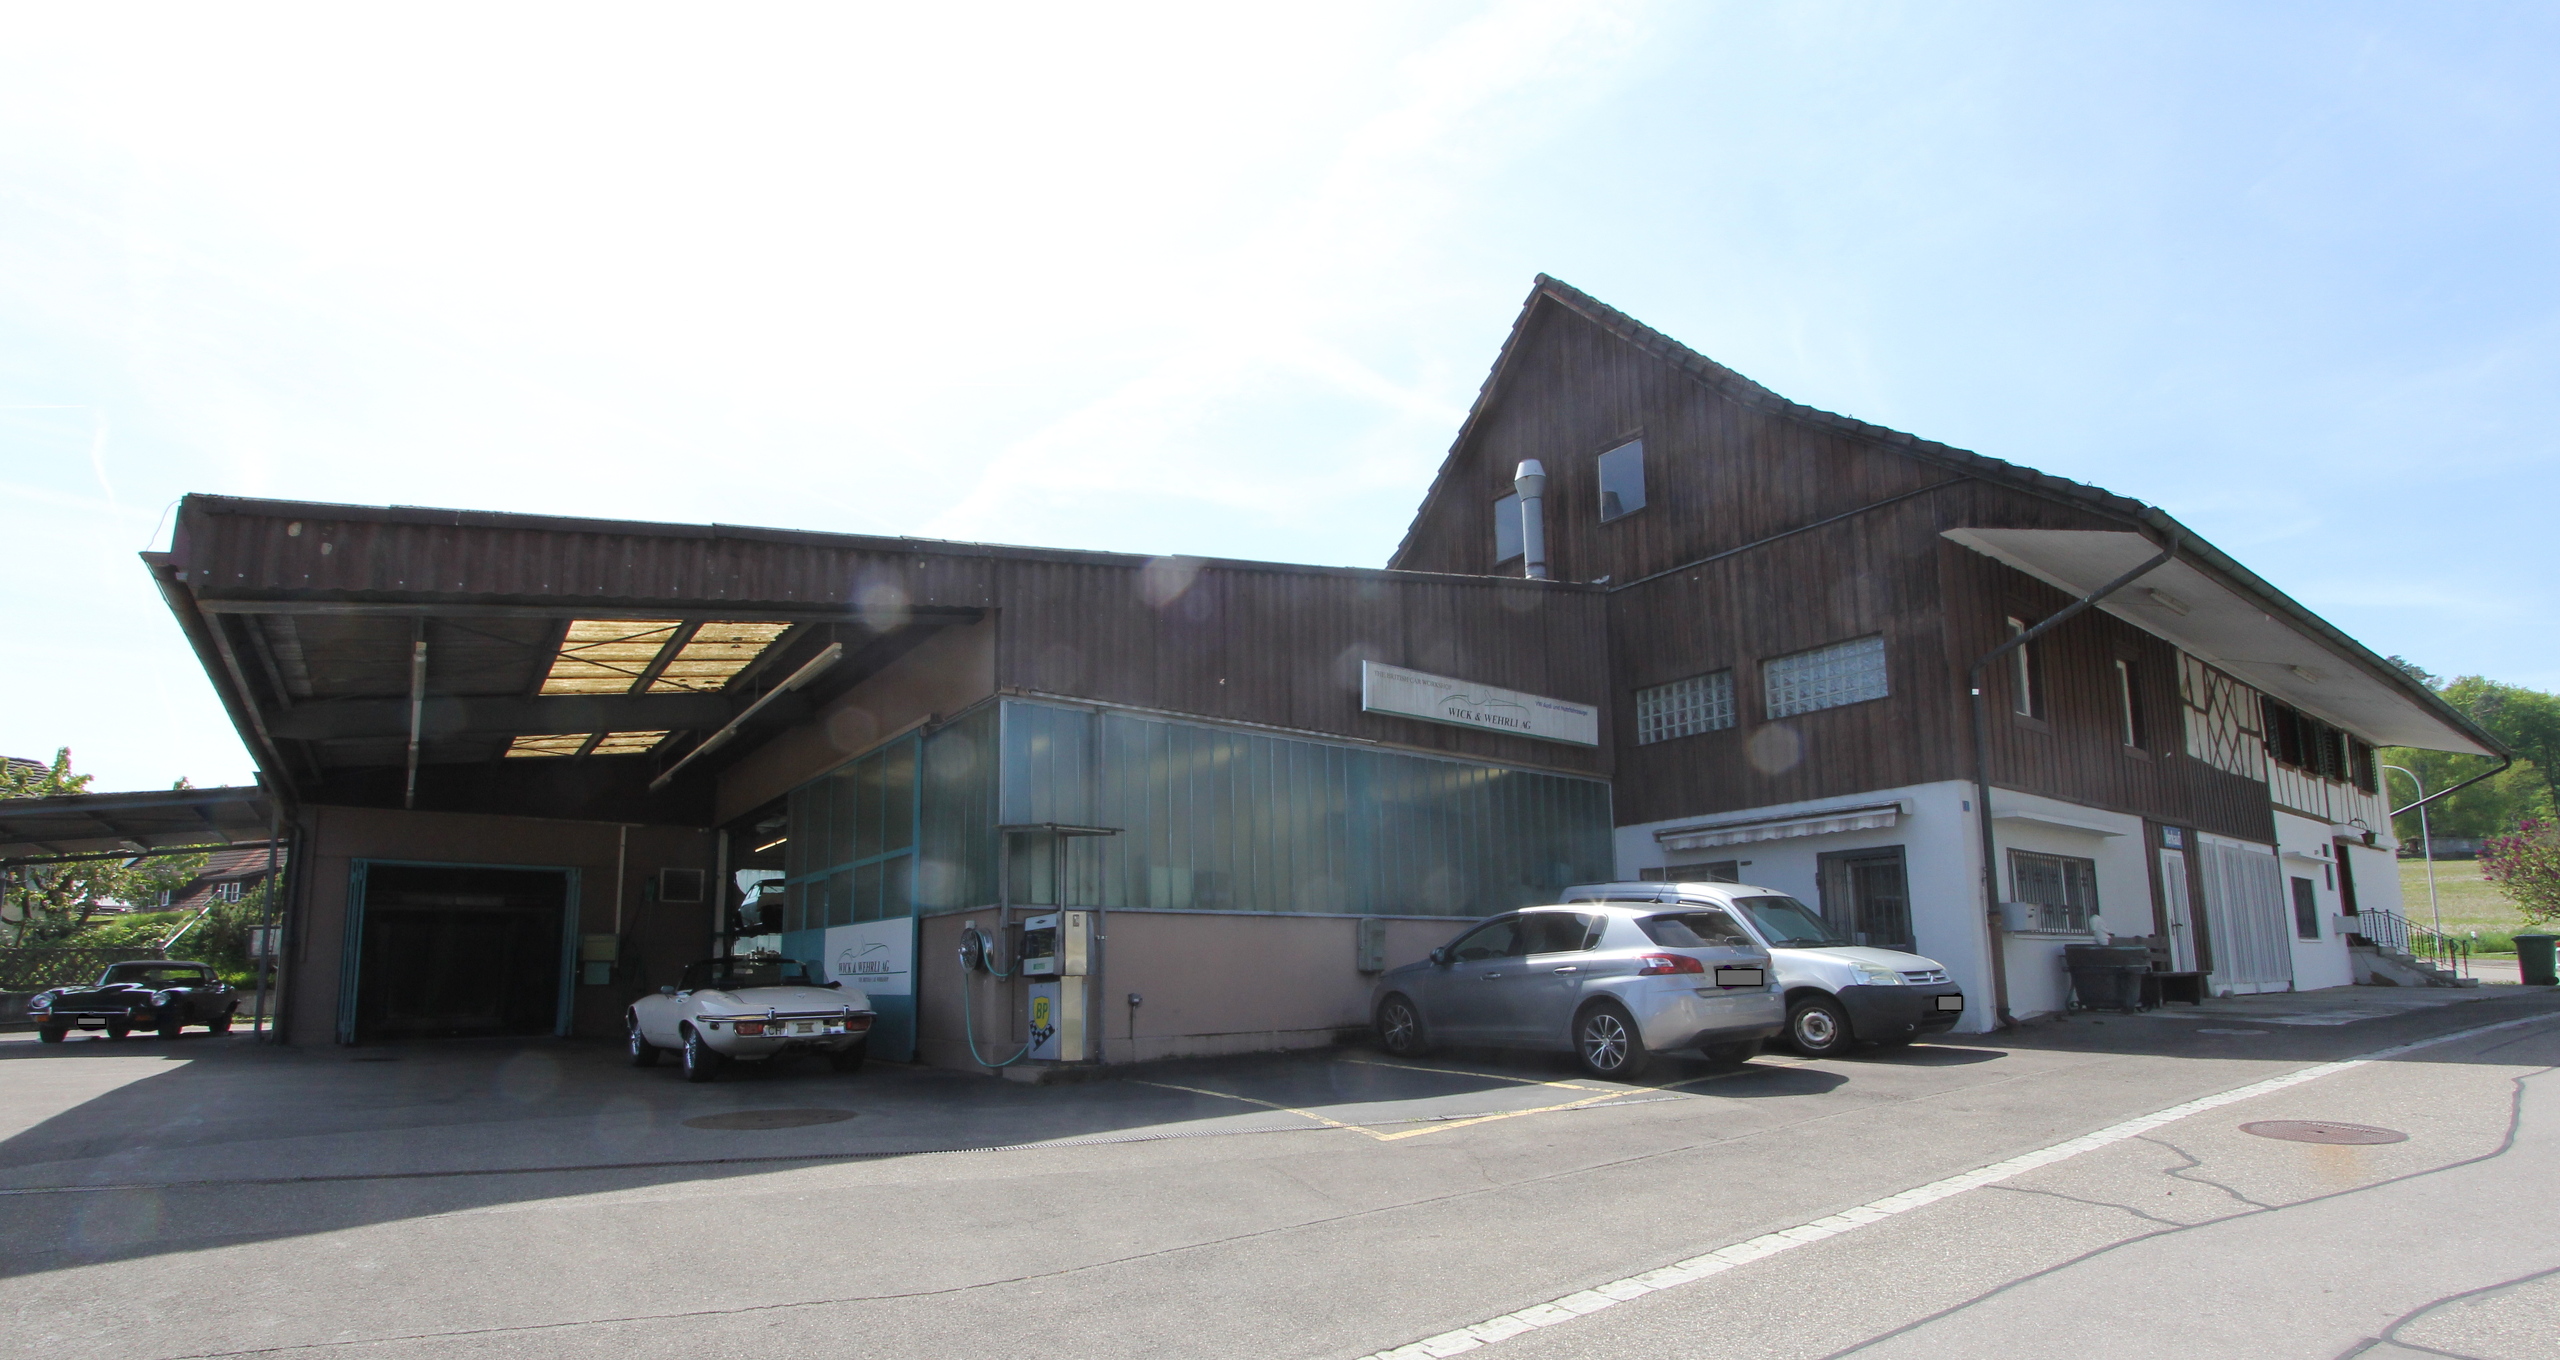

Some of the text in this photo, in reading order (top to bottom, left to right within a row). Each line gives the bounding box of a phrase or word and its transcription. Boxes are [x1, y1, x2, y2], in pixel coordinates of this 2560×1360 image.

[1374, 670, 1386, 678] THE
[1387, 673, 1409, 682] BRITISH
[1422, 680, 1452, 690] WORKSHOP
[1448, 707, 1531, 729] WICK & WEHRLI AG
[838, 960, 889, 973] WICK & WEHRLI AG
[1036, 1002, 1048, 1019] BP
[768, 1026, 782, 1035] CH
